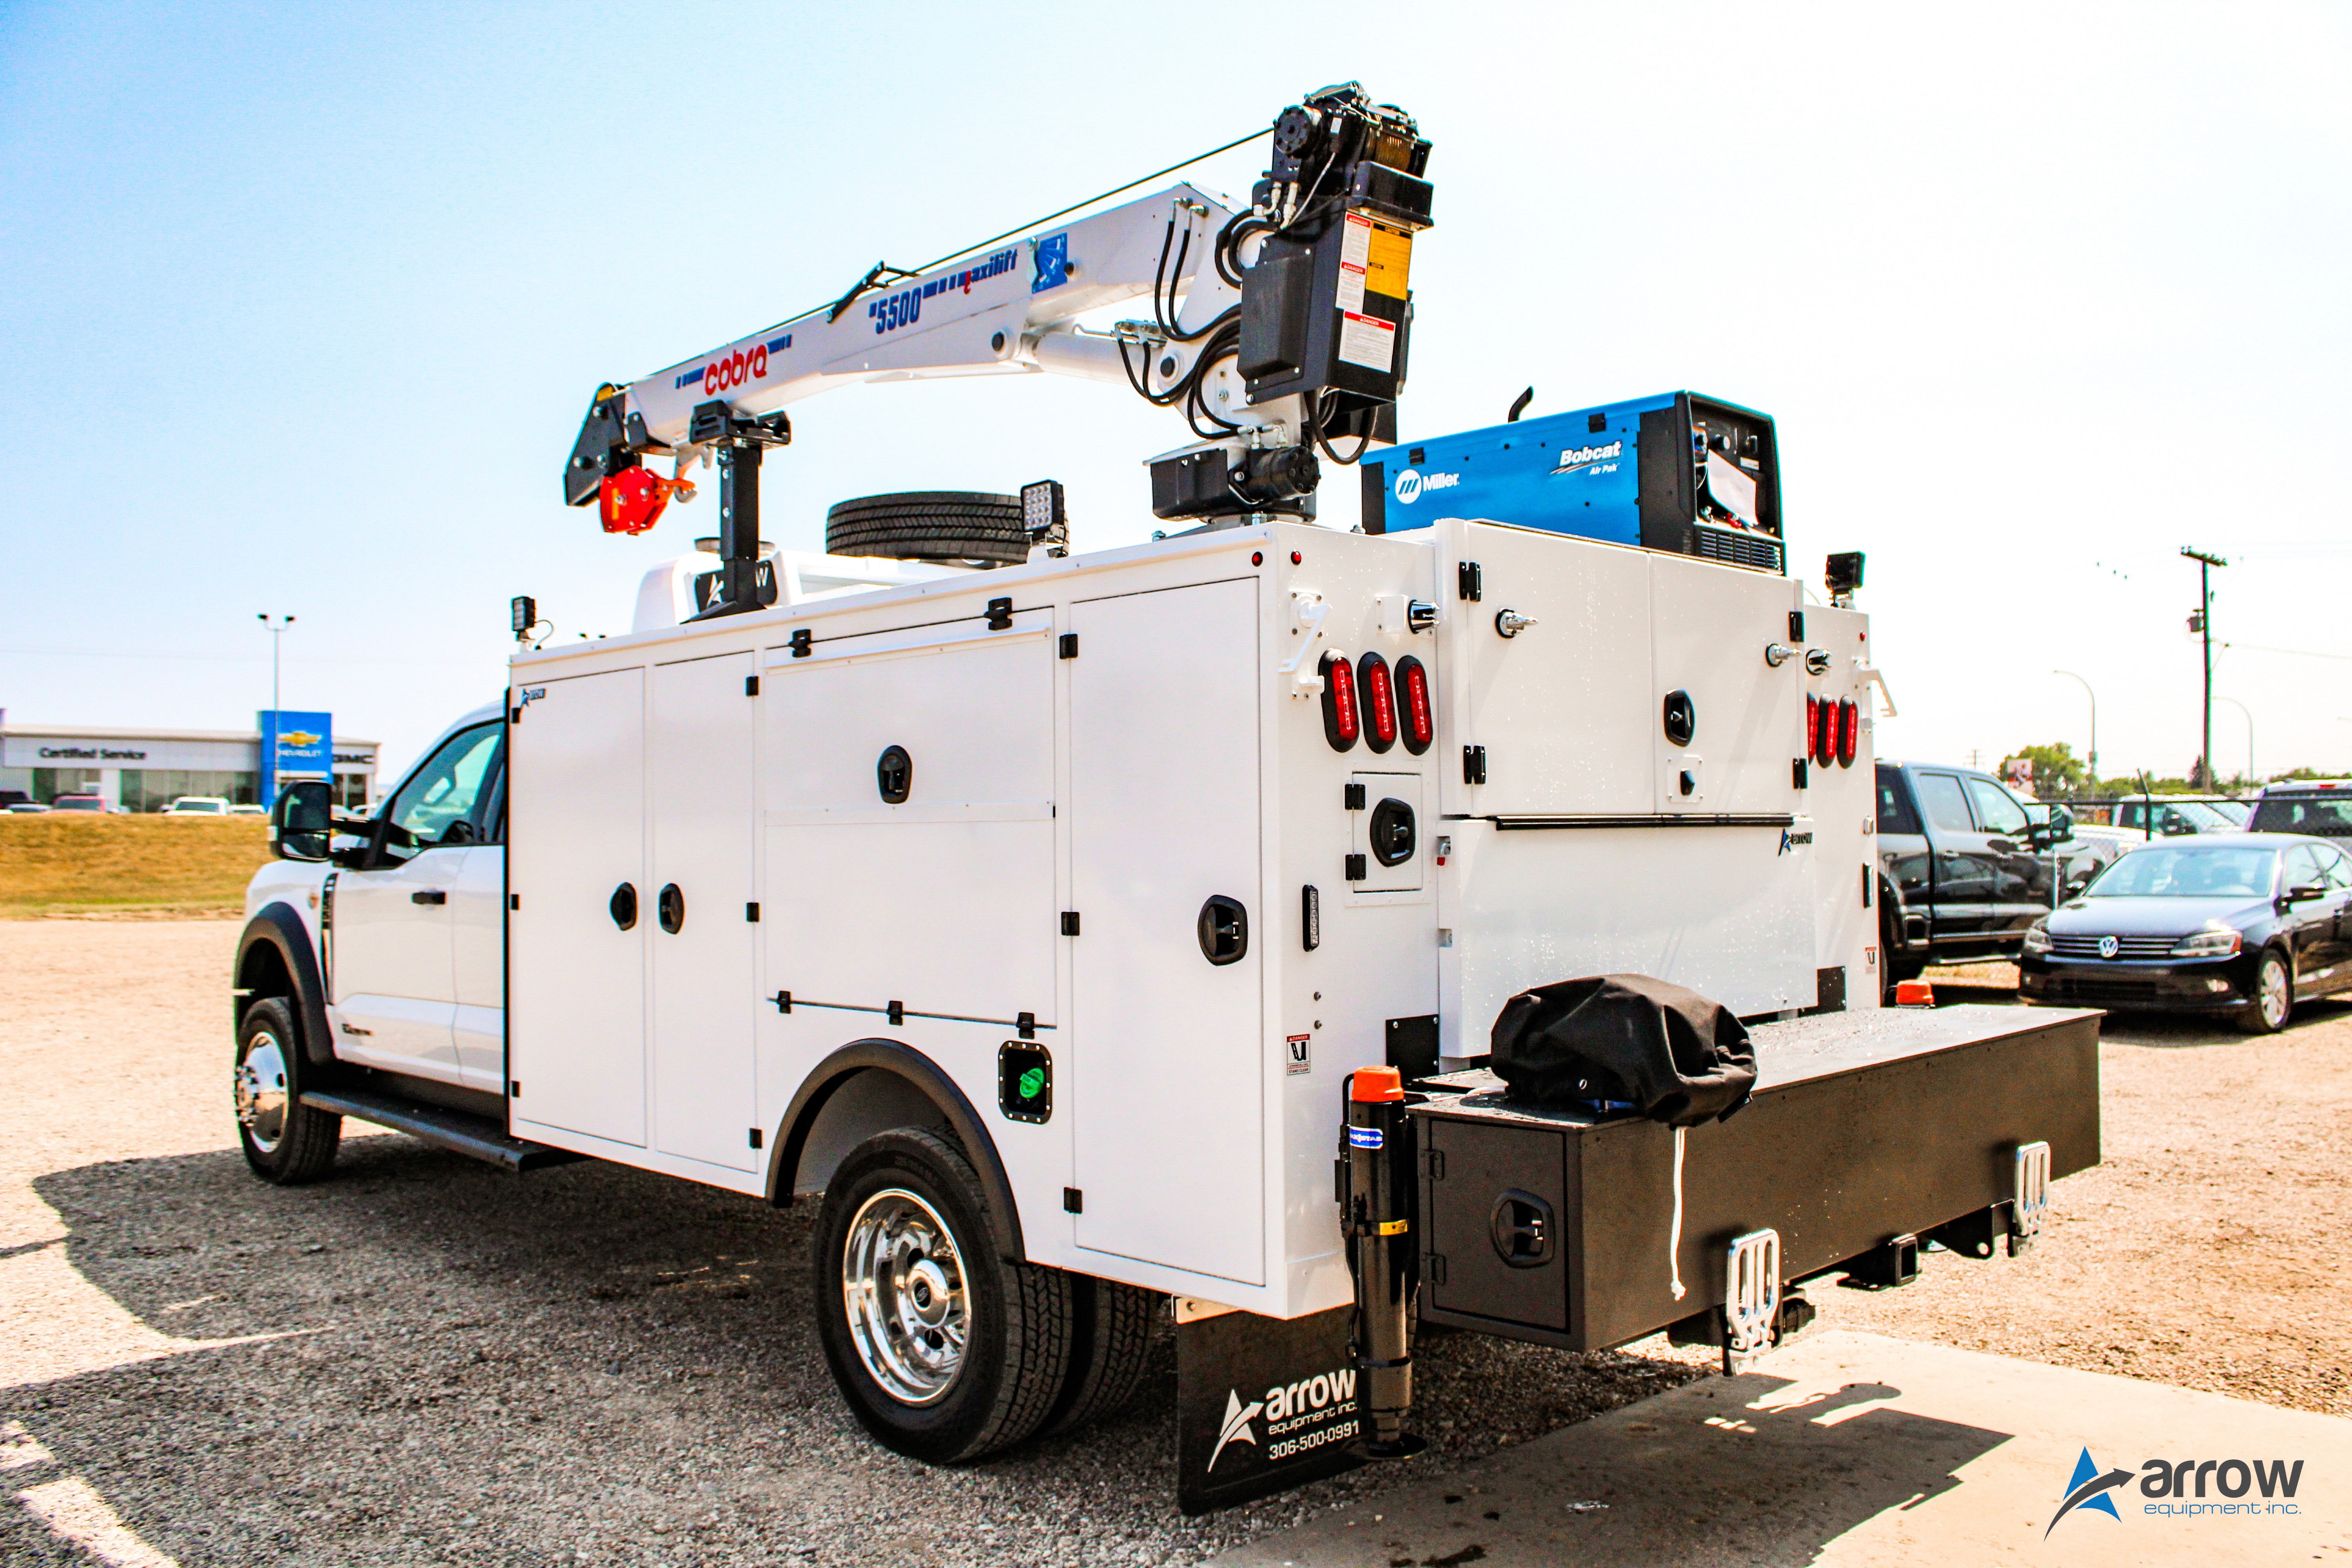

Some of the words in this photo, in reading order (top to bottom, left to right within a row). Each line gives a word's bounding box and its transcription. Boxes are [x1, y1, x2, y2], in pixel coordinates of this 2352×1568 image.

[1352, 218, 1368, 226] DANGER
[1347, 265, 1363, 274] DANGER
[876, 287, 921, 334] 5500
[1363, 318, 1379, 326] DANGER
[705, 344, 768, 396] cobra
[1560, 441, 1621, 466] Bobcat
[1590, 466, 1602, 475] Air
[1602, 463, 1617, 473] Pak
[1423, 472, 1460, 492] Miller
[38, 747, 96, 759] Certified
[100, 748, 147, 760] Service
[276, 749, 321, 757] HEVROLET
[1266, 1369, 1356, 1422] arrow
[1269, 1406, 1336, 1436] equipment
[1338, 1401, 1358, 1414] inc.
[1269, 1420, 1359, 1460] 306-500-0991
